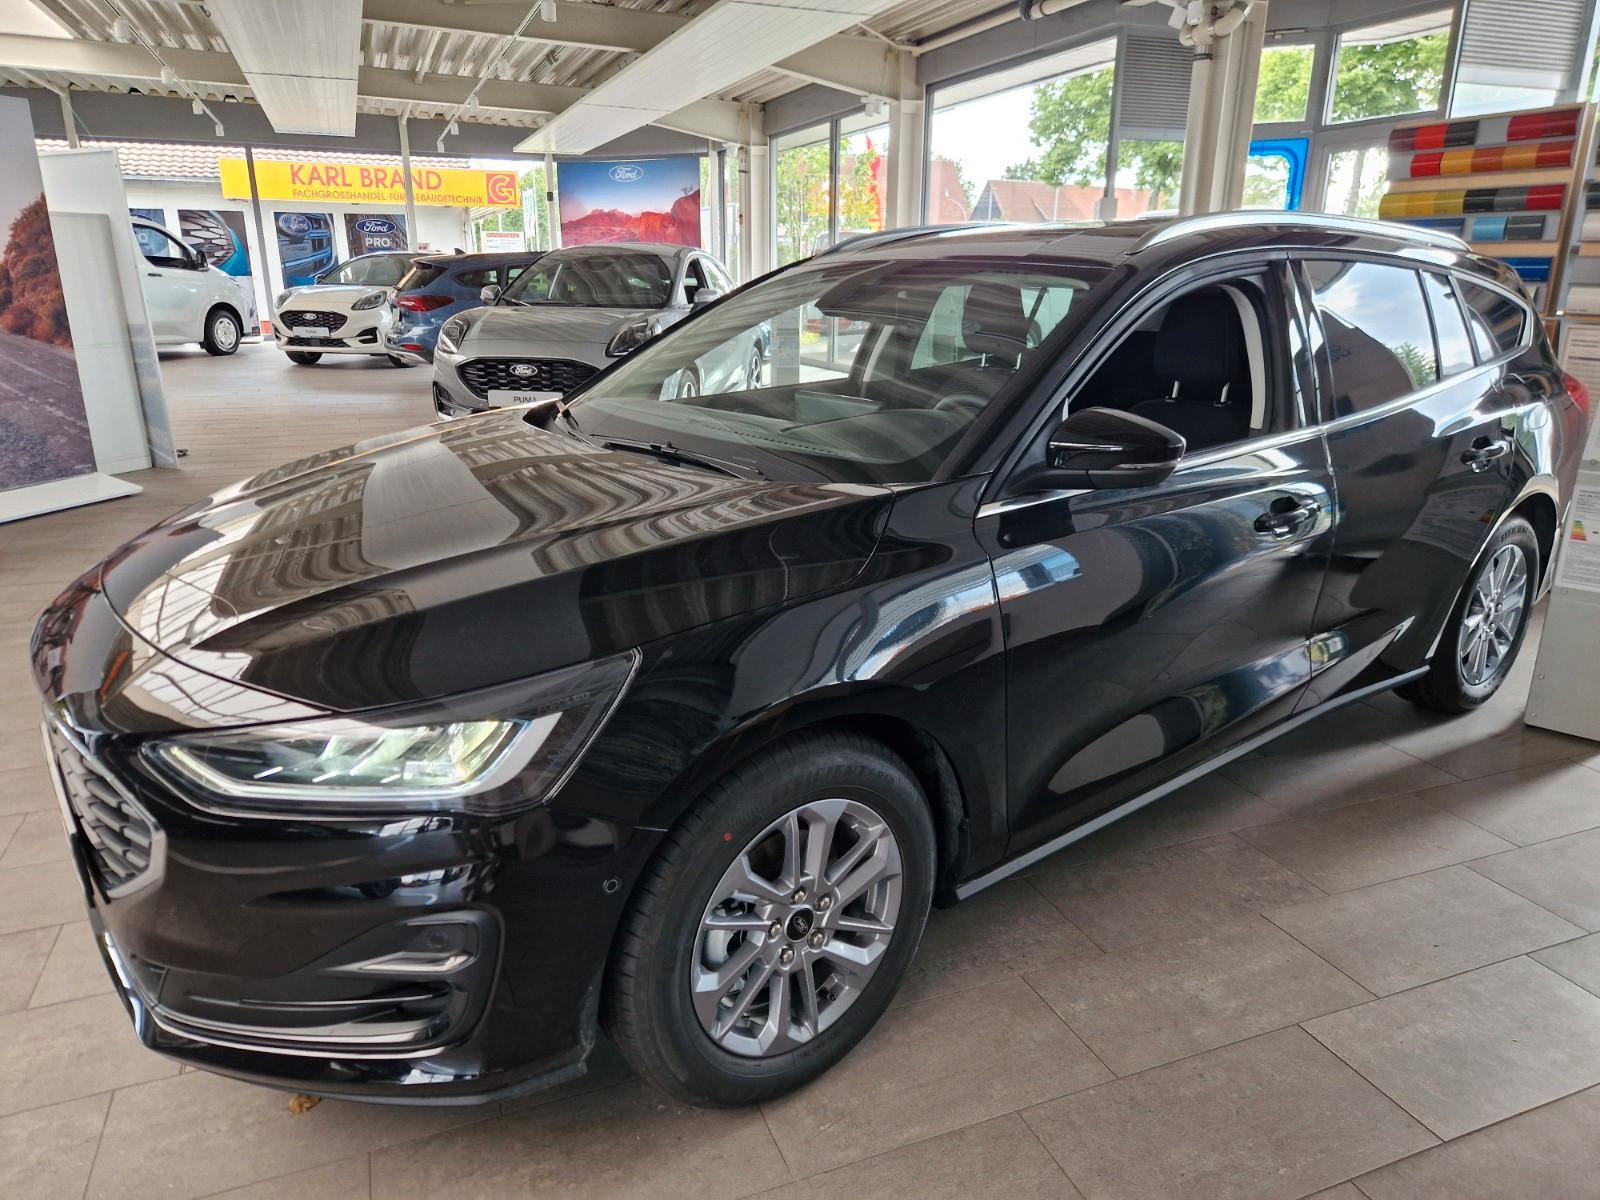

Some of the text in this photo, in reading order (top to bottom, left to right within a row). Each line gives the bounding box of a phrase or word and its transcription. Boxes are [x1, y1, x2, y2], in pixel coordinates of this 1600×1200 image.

[290, 164, 442, 190] KARL BRAND
[293, 189, 386, 201] FACHGROSSHANDEL
[414, 192, 484, 204] EBÄUDETECHNIK
[363, 221, 388, 232] Ford
[366, 237, 390, 247] PRO
